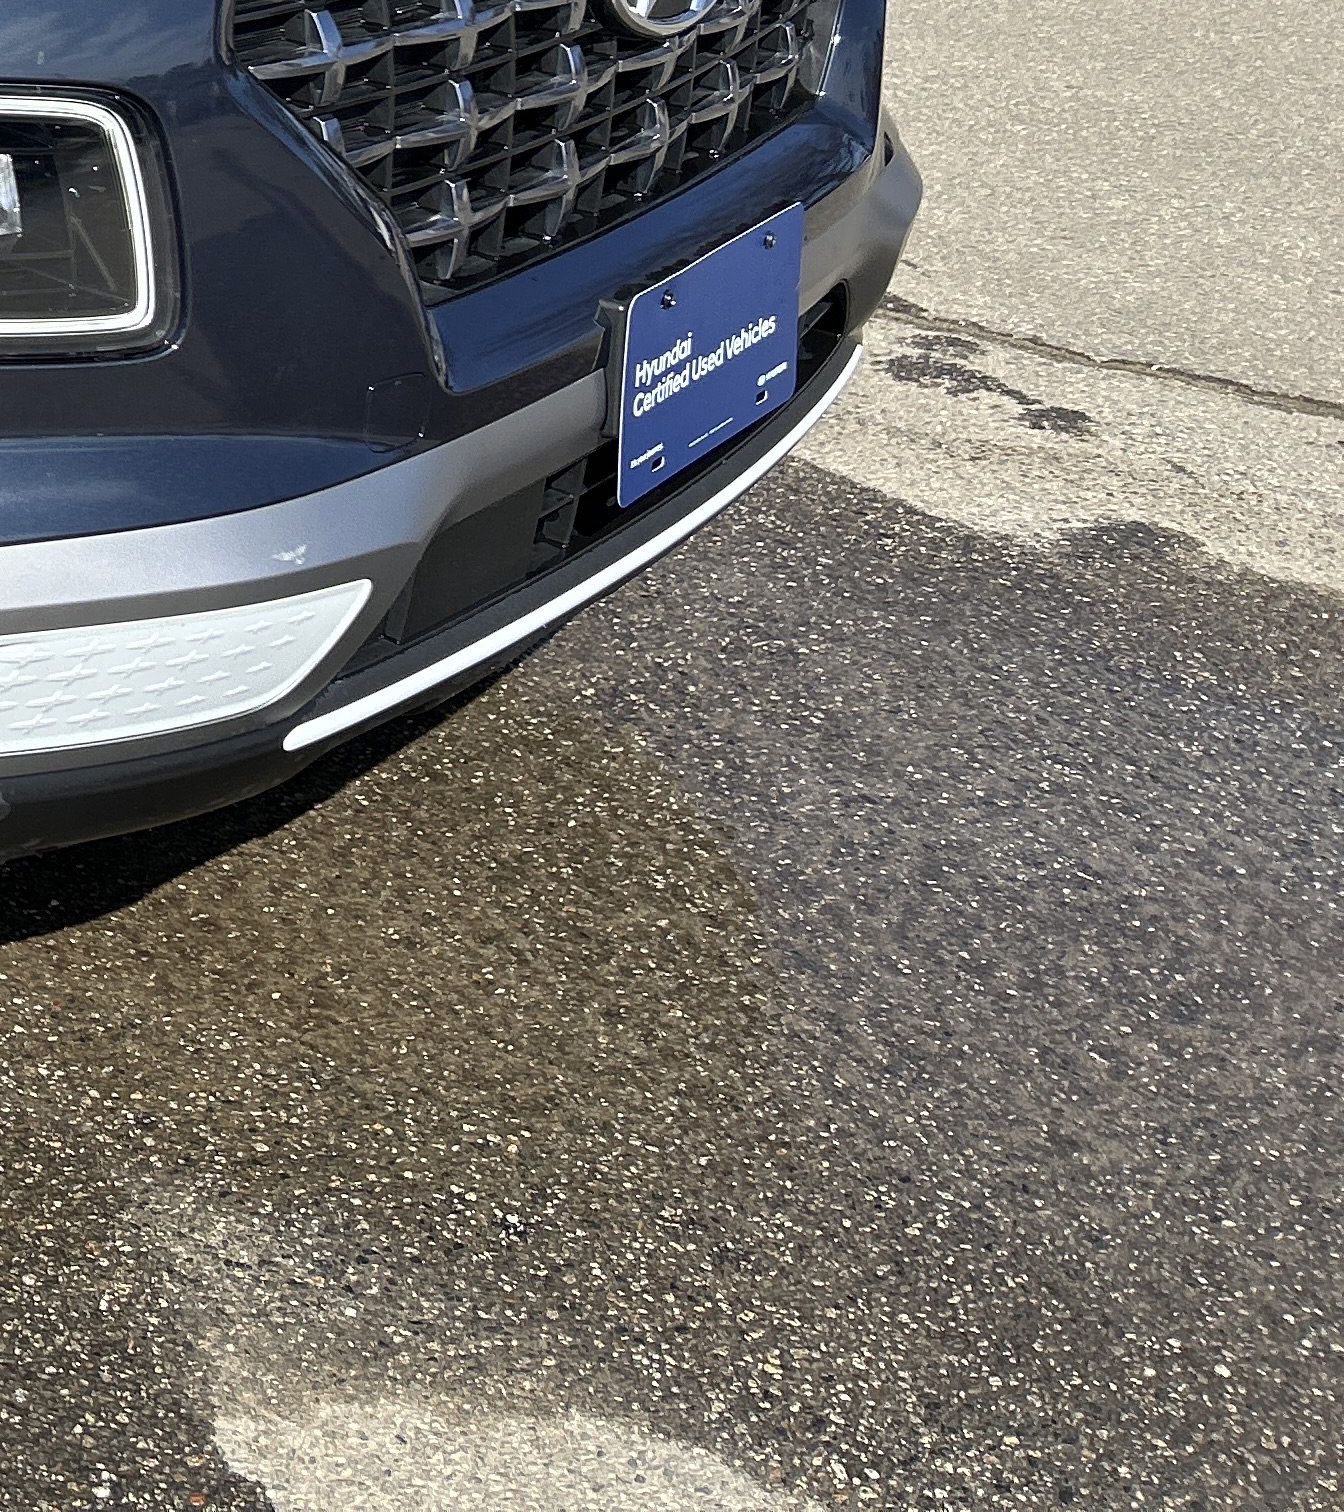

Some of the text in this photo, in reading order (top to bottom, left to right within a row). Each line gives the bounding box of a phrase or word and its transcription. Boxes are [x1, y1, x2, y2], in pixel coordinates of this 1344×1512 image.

[633, 362, 691, 417] Certified
[691, 340, 724, 380] Used
[725, 315, 776, 360] Vehicles
[634, 332, 693, 388] Hyundai
